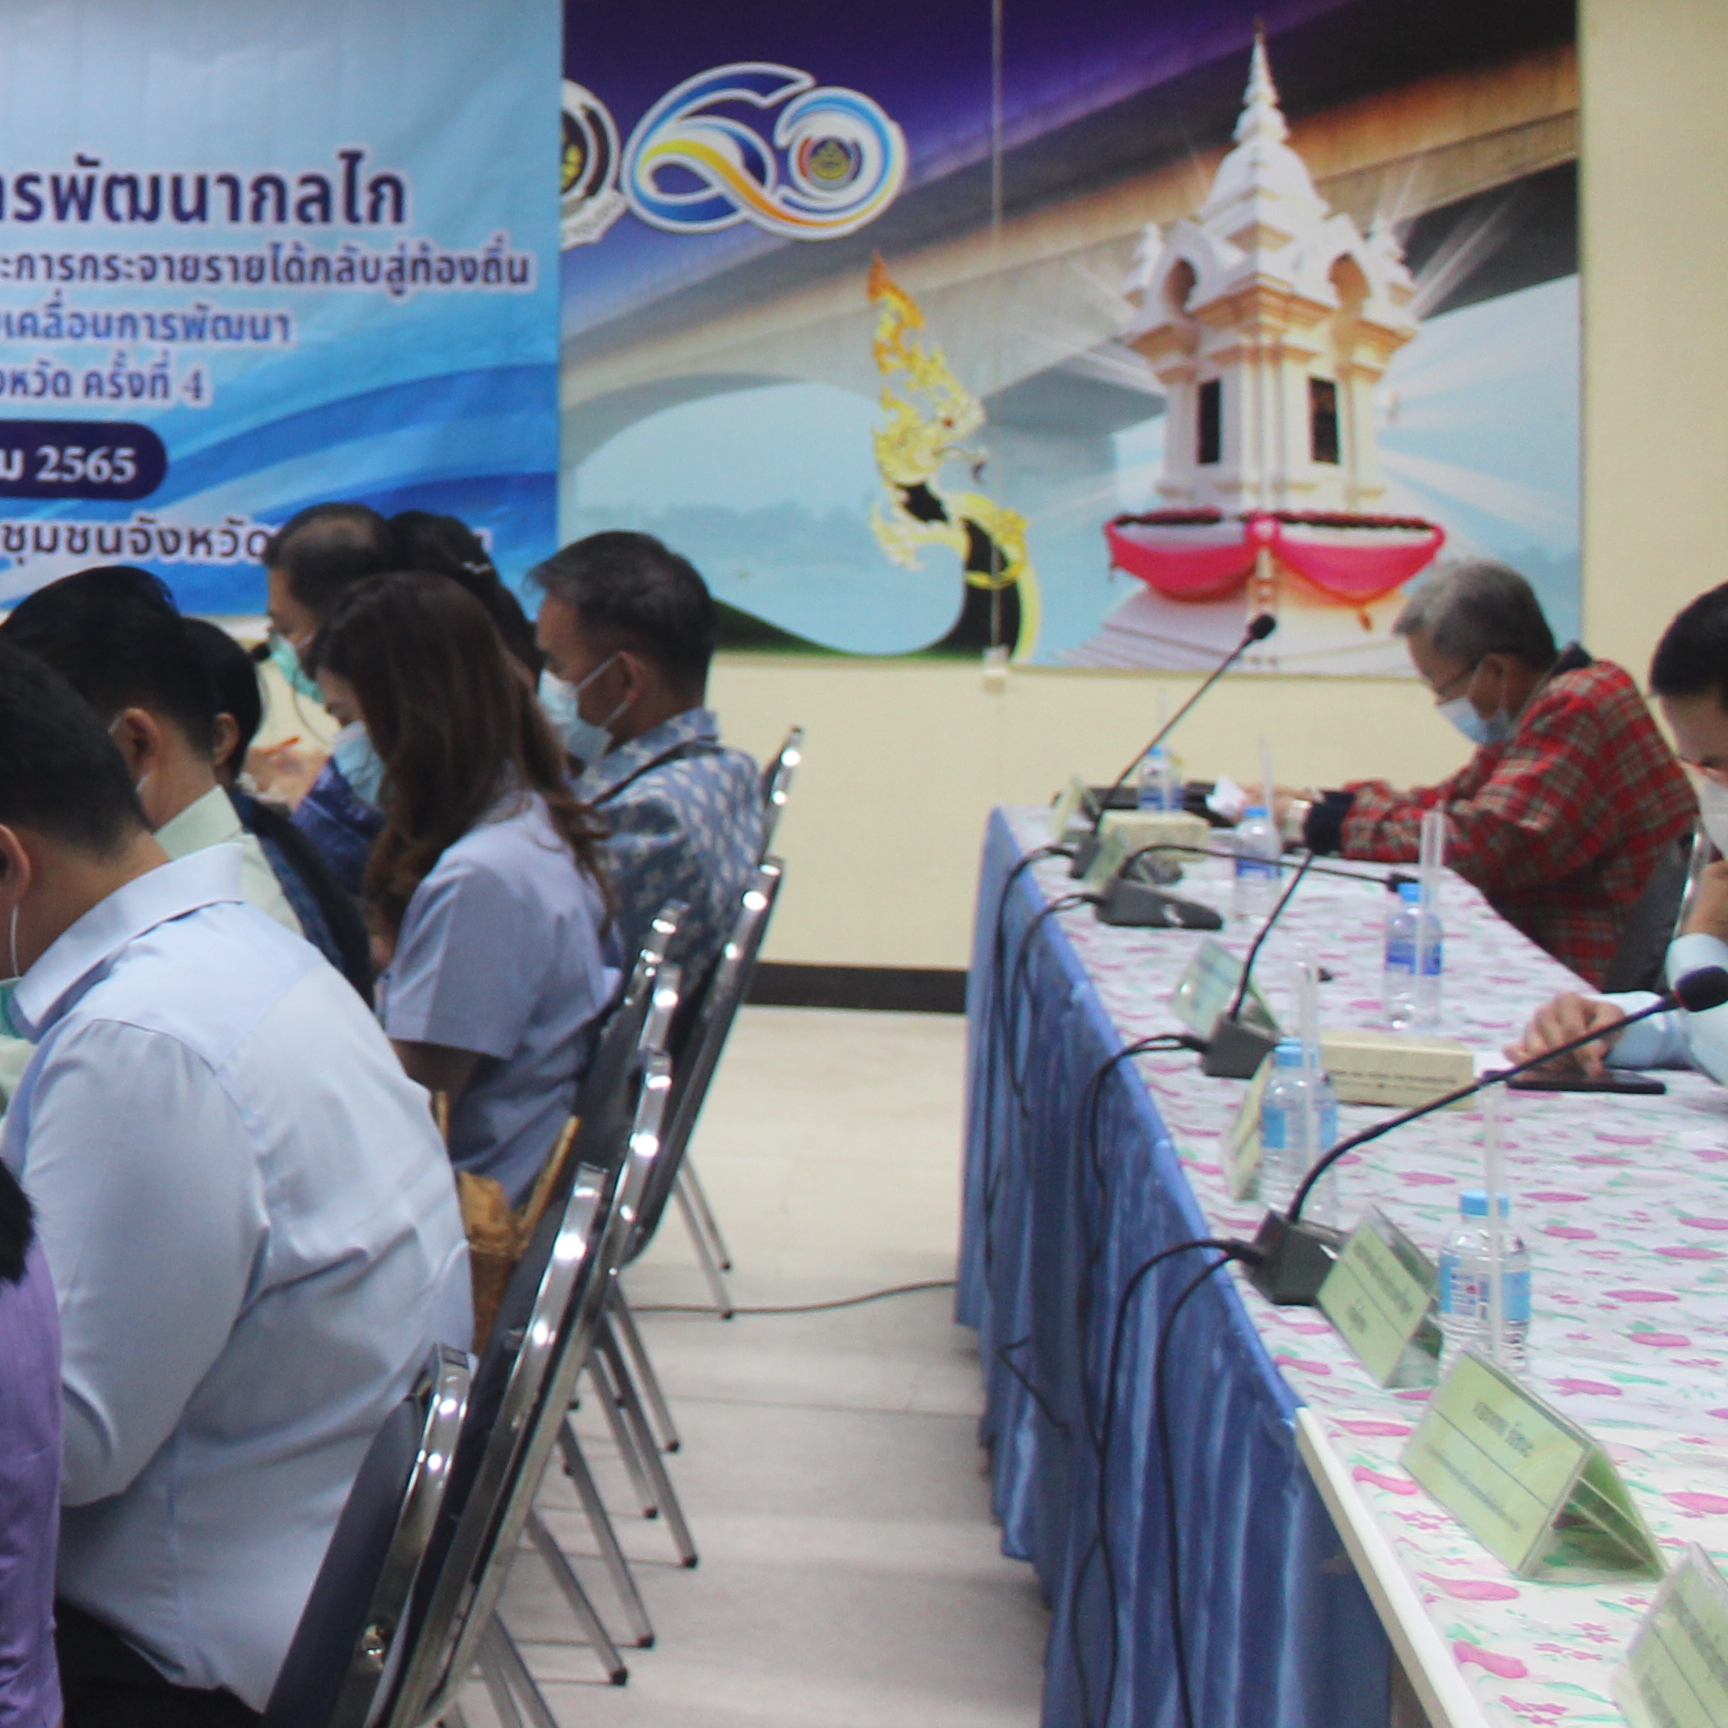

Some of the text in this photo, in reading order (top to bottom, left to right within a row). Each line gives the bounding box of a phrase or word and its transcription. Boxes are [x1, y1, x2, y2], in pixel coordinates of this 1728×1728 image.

[84, 349, 171, 400] ครั้งที่
[183, 368, 204, 400] 4
[35, 445, 137, 484] 2565
